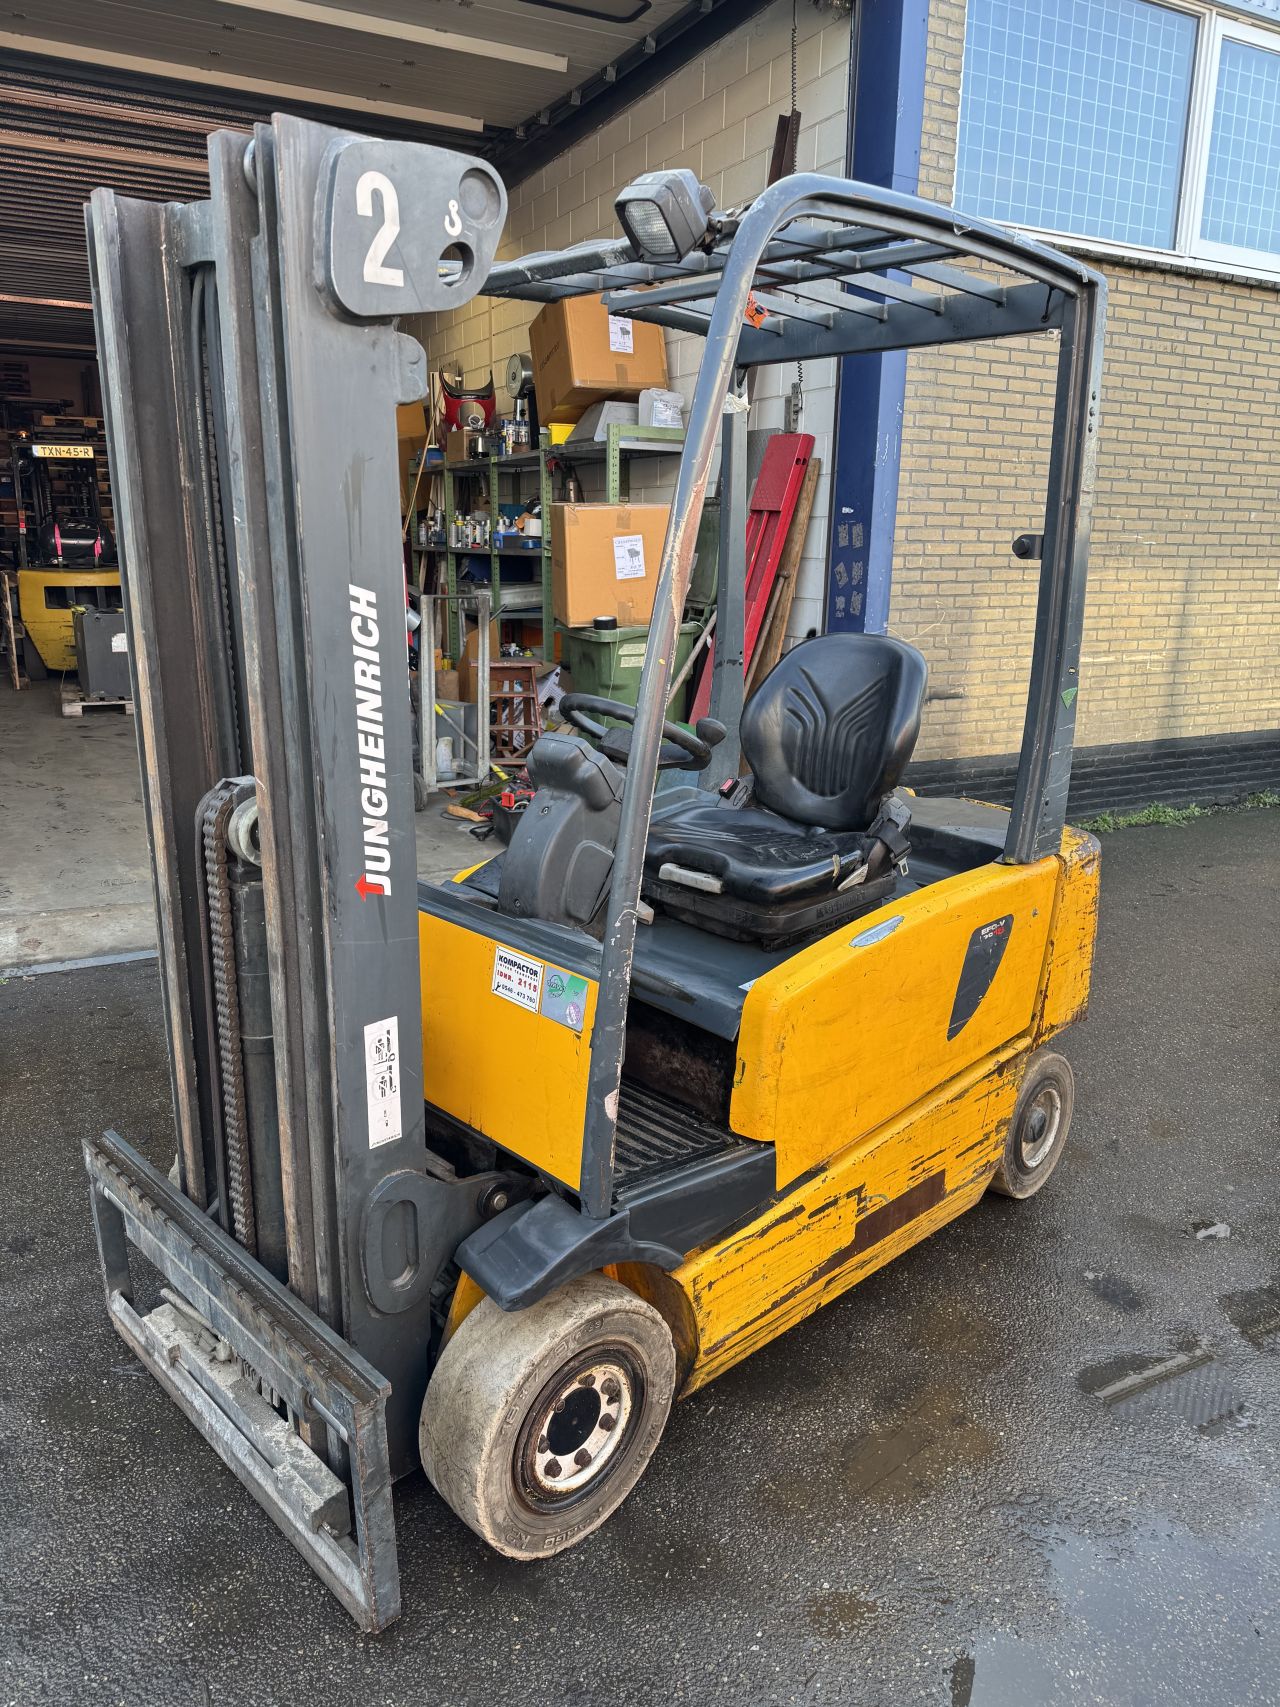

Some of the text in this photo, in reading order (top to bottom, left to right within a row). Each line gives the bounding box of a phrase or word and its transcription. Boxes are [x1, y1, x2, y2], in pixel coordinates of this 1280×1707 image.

[356, 171, 404, 287] 2
[41, 446, 90, 456] TXN-45-R
[349, 584, 391, 897] JUNGHEINRICH
[498, 955, 538, 977] KOMPACTOR
[518, 978, 537, 992] 2115
